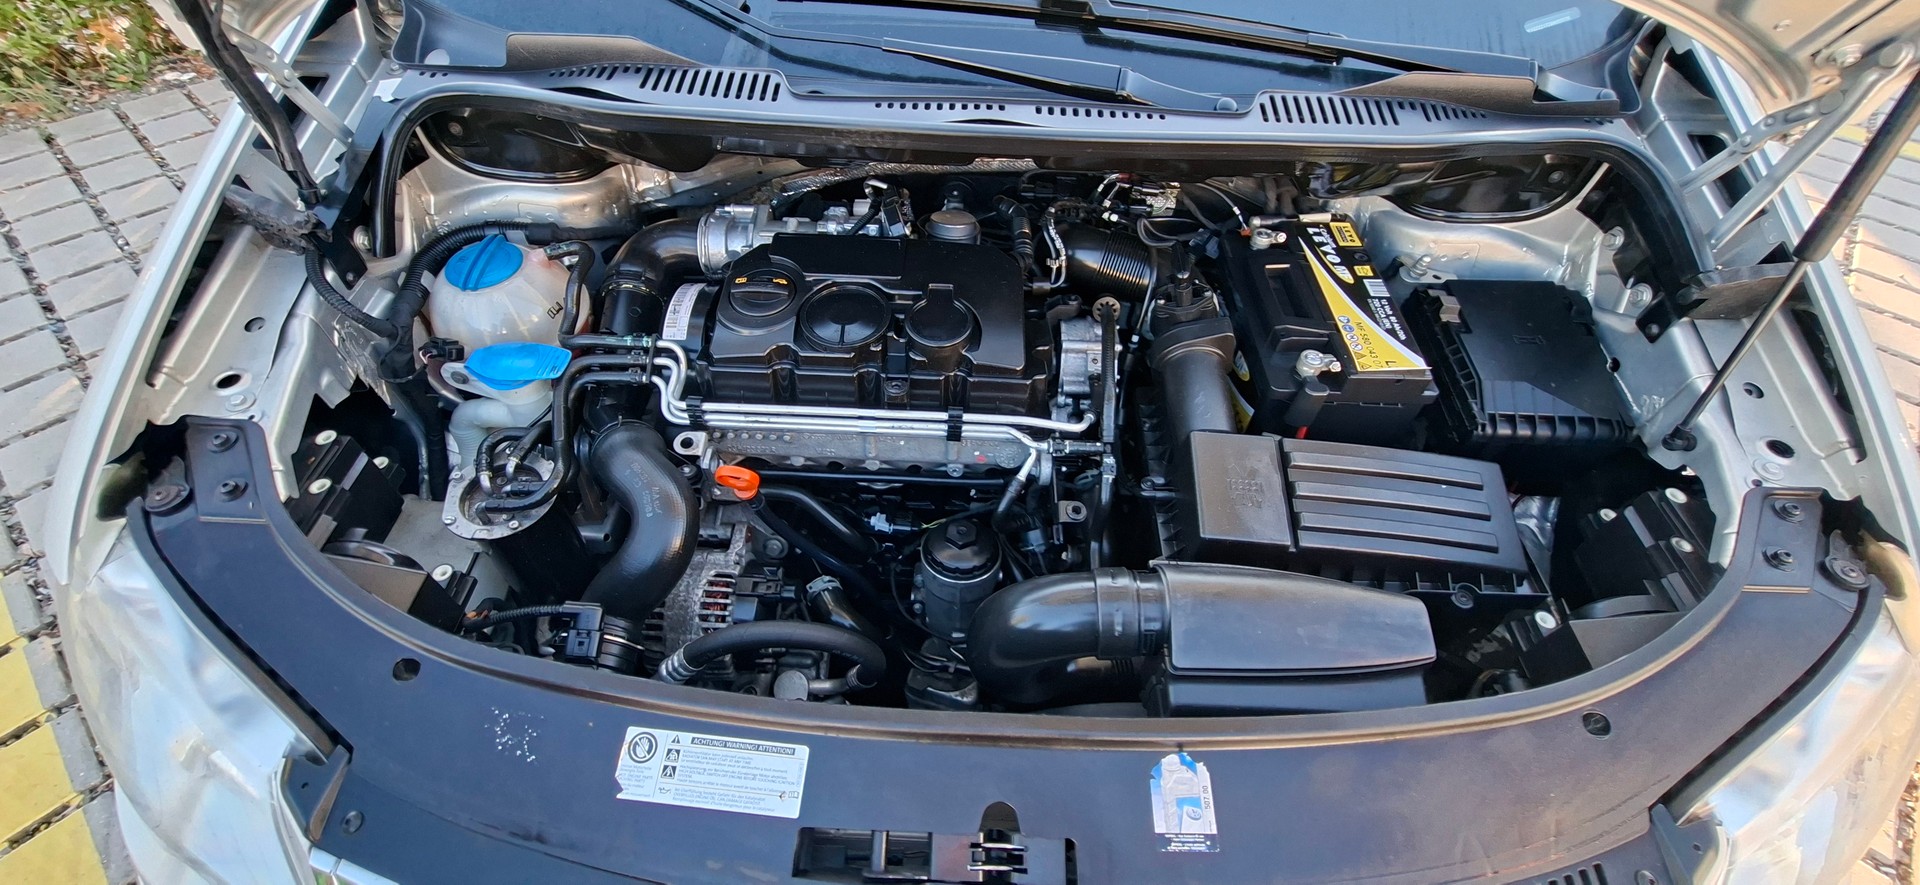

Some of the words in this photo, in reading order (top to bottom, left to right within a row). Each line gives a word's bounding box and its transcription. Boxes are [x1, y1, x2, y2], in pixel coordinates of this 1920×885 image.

[1342, 226, 1356, 243] LEVO
[1306, 227, 1341, 264] LEVO
[1377, 307, 1387, 318] CCA
[1383, 305, 1393, 315] Volt
[1354, 321, 1366, 332] MF
[693, 739, 725, 747] ACHTUNG!
[726, 742, 758, 750] WARNING!
[758, 746, 794, 755] ATTENTION!
[1202, 785, 1209, 794] 00
